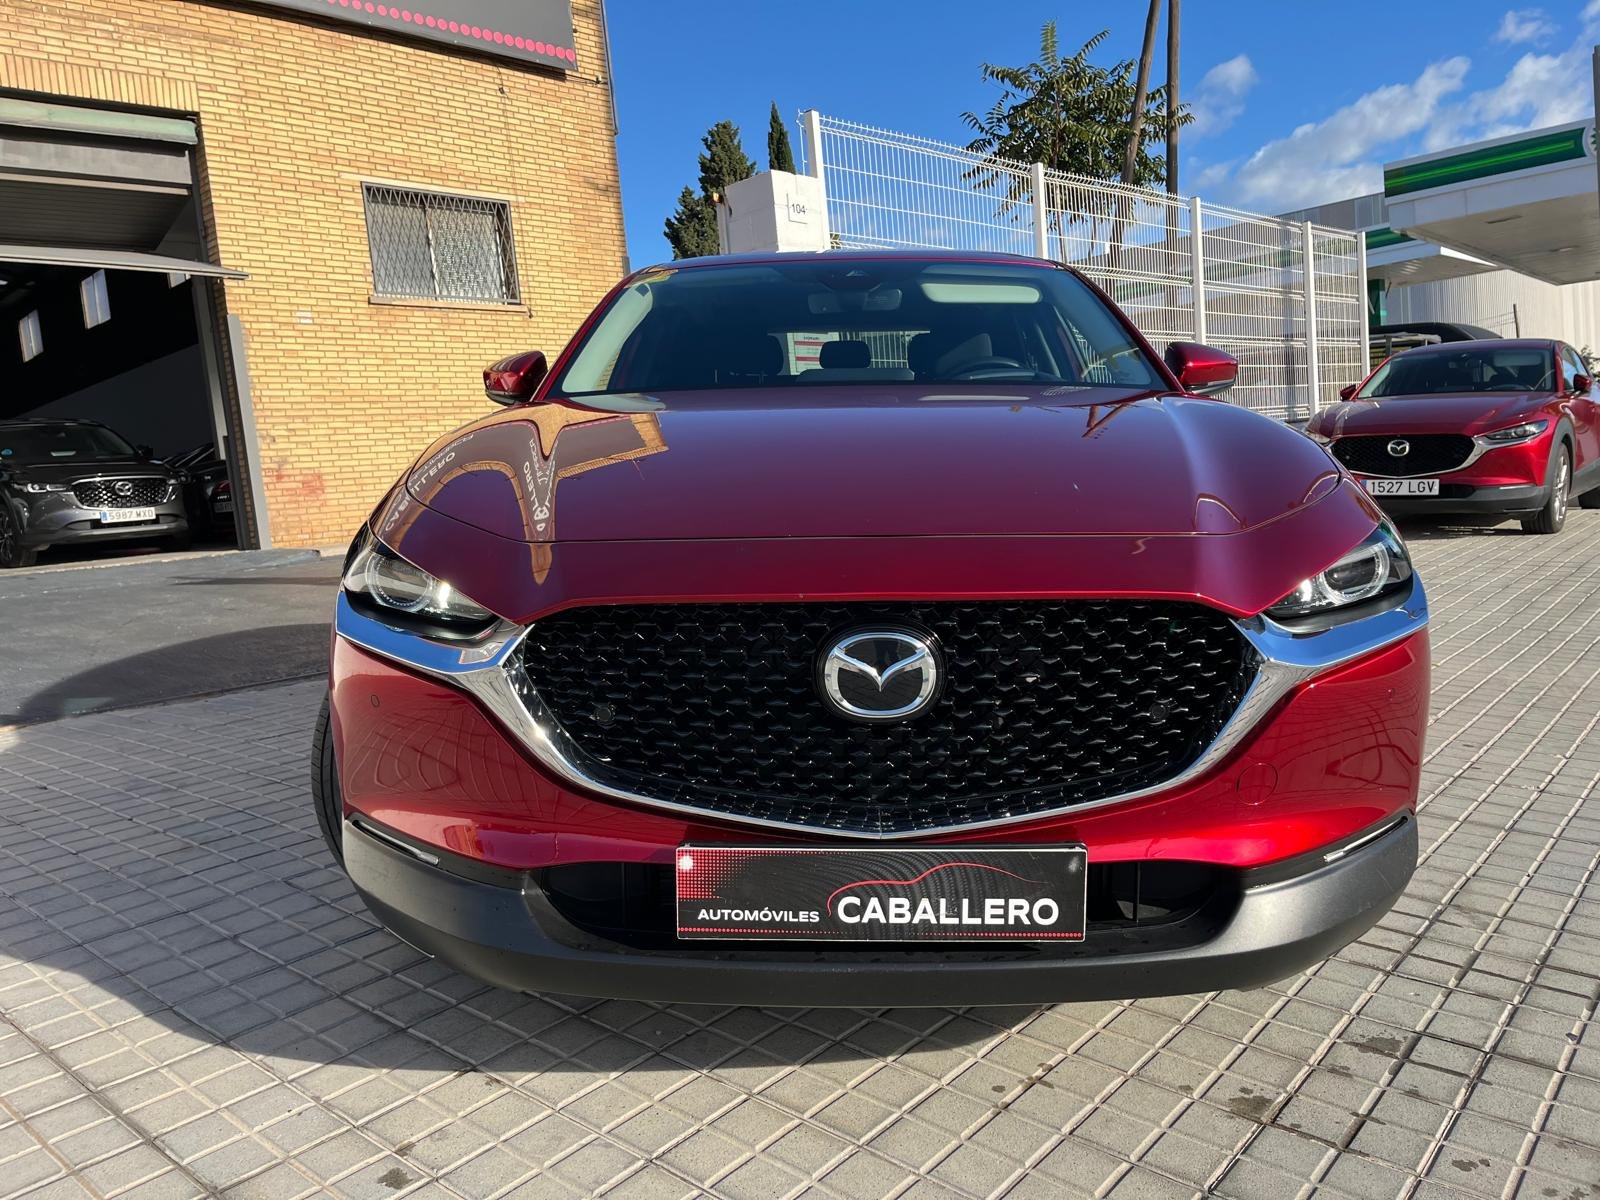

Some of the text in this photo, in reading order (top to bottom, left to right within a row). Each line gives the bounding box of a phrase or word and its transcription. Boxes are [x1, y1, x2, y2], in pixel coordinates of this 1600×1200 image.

[791, 203, 806, 215] 104
[1371, 481, 1435, 494] 1527 LGV
[109, 510, 133, 520] 5987
[697, 896, 1059, 926] AUTOMÓVILES CABALLERO
